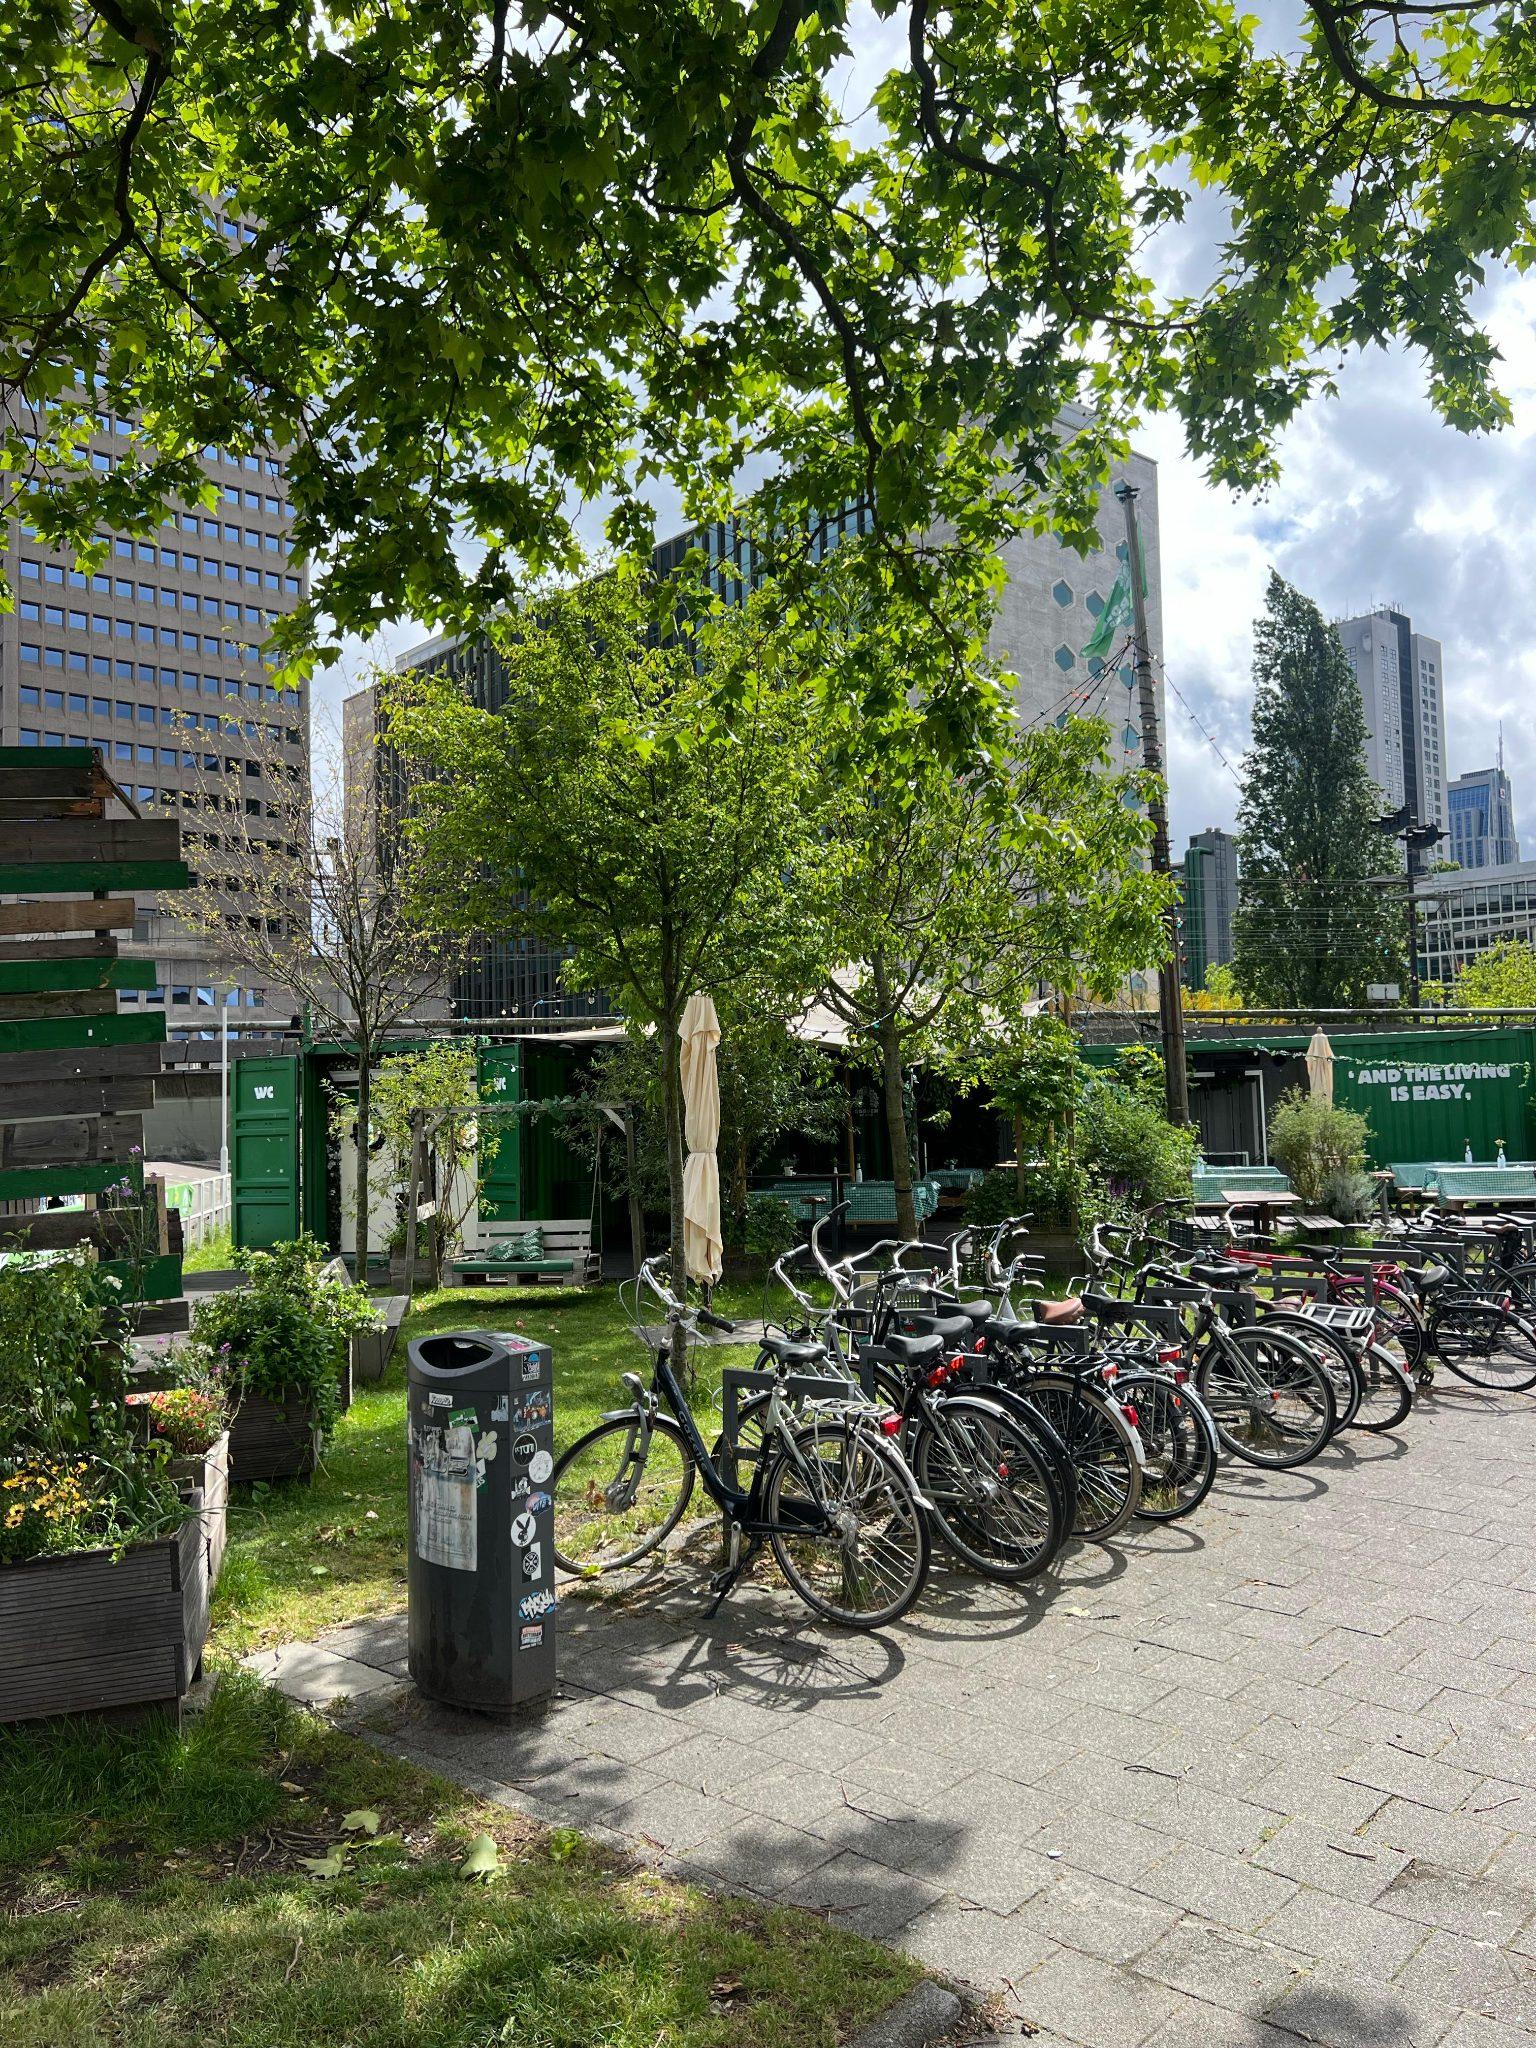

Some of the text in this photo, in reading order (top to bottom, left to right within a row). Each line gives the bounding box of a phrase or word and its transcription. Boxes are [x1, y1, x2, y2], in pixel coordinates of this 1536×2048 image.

[1404, 1067, 1442, 1082] THE
[1444, 1065, 1511, 1081] LIVING
[254, 1086, 274, 1099] WC
[1390, 1086, 1409, 1102] IS
